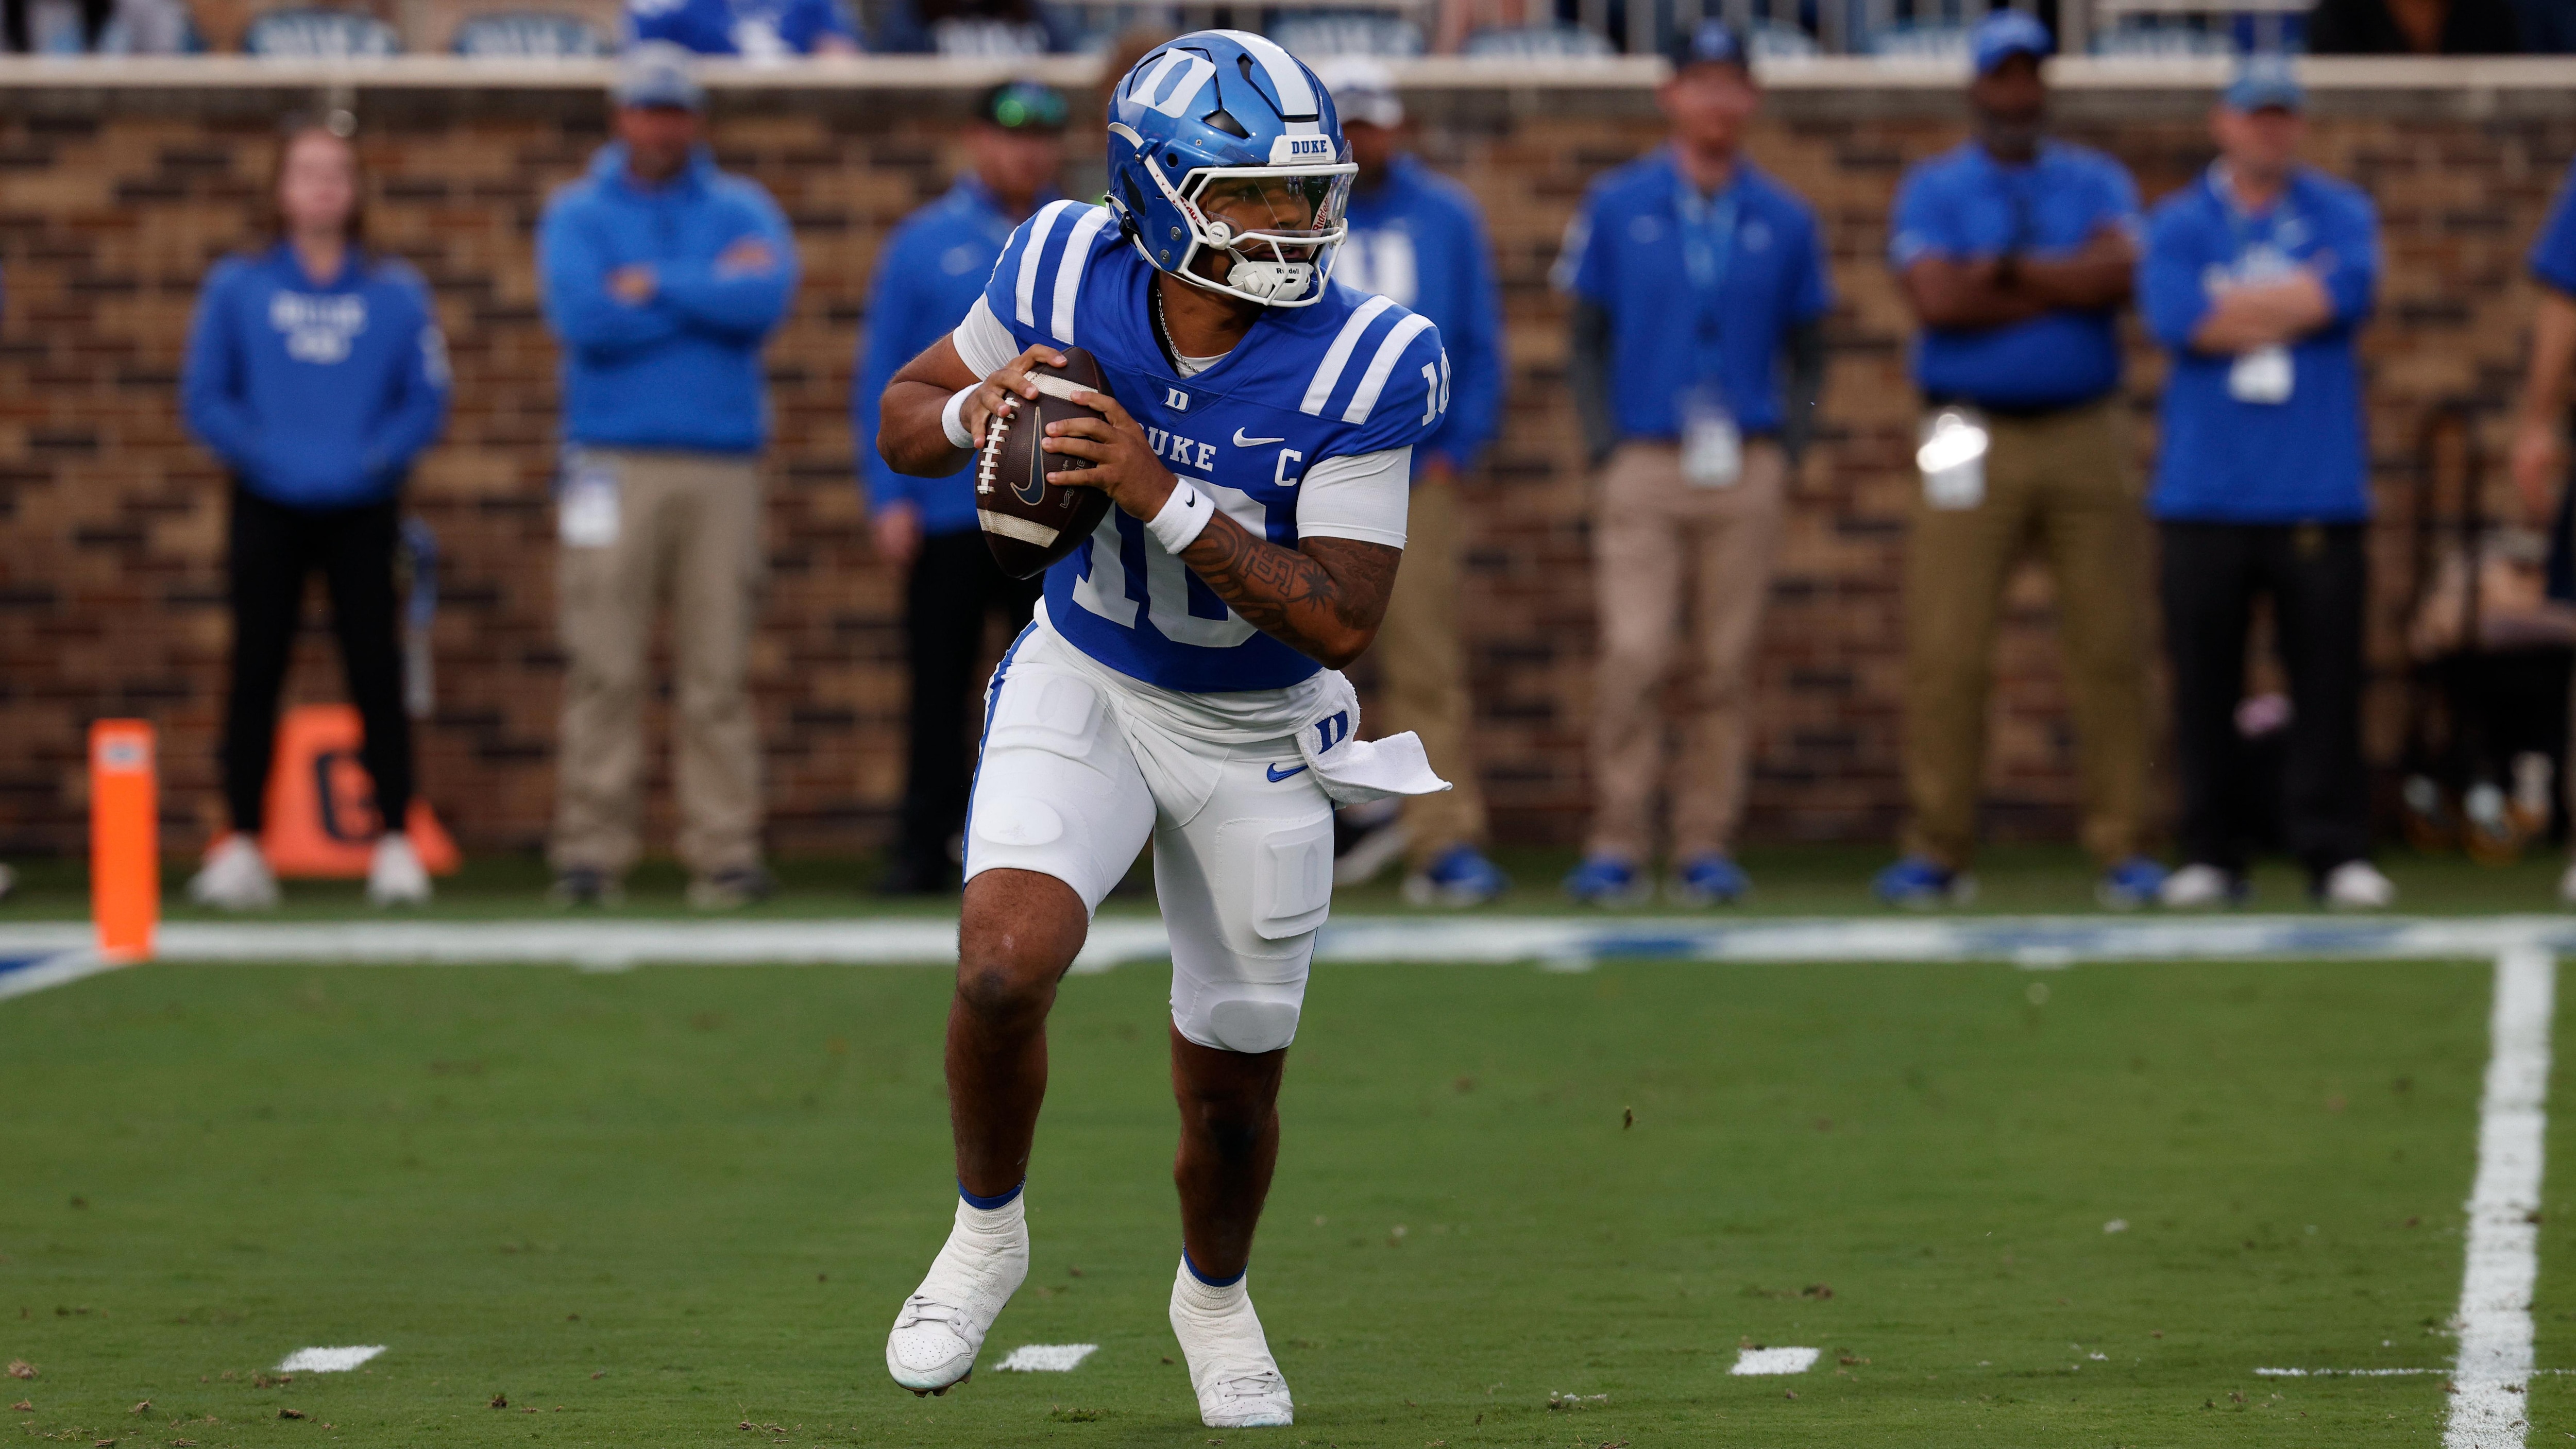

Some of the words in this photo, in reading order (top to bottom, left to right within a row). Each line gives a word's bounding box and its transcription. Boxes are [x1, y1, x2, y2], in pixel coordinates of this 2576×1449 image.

[1128, 47, 1217, 118] D
[1291, 140, 1328, 154] DUKE
[1164, 387, 1190, 411] D
[1421, 346, 1451, 427] 10
[1138, 423, 1217, 472] UKE
[1274, 447, 1302, 487] C
[1072, 472, 1267, 648] 10
[1314, 710, 1348, 755] D
